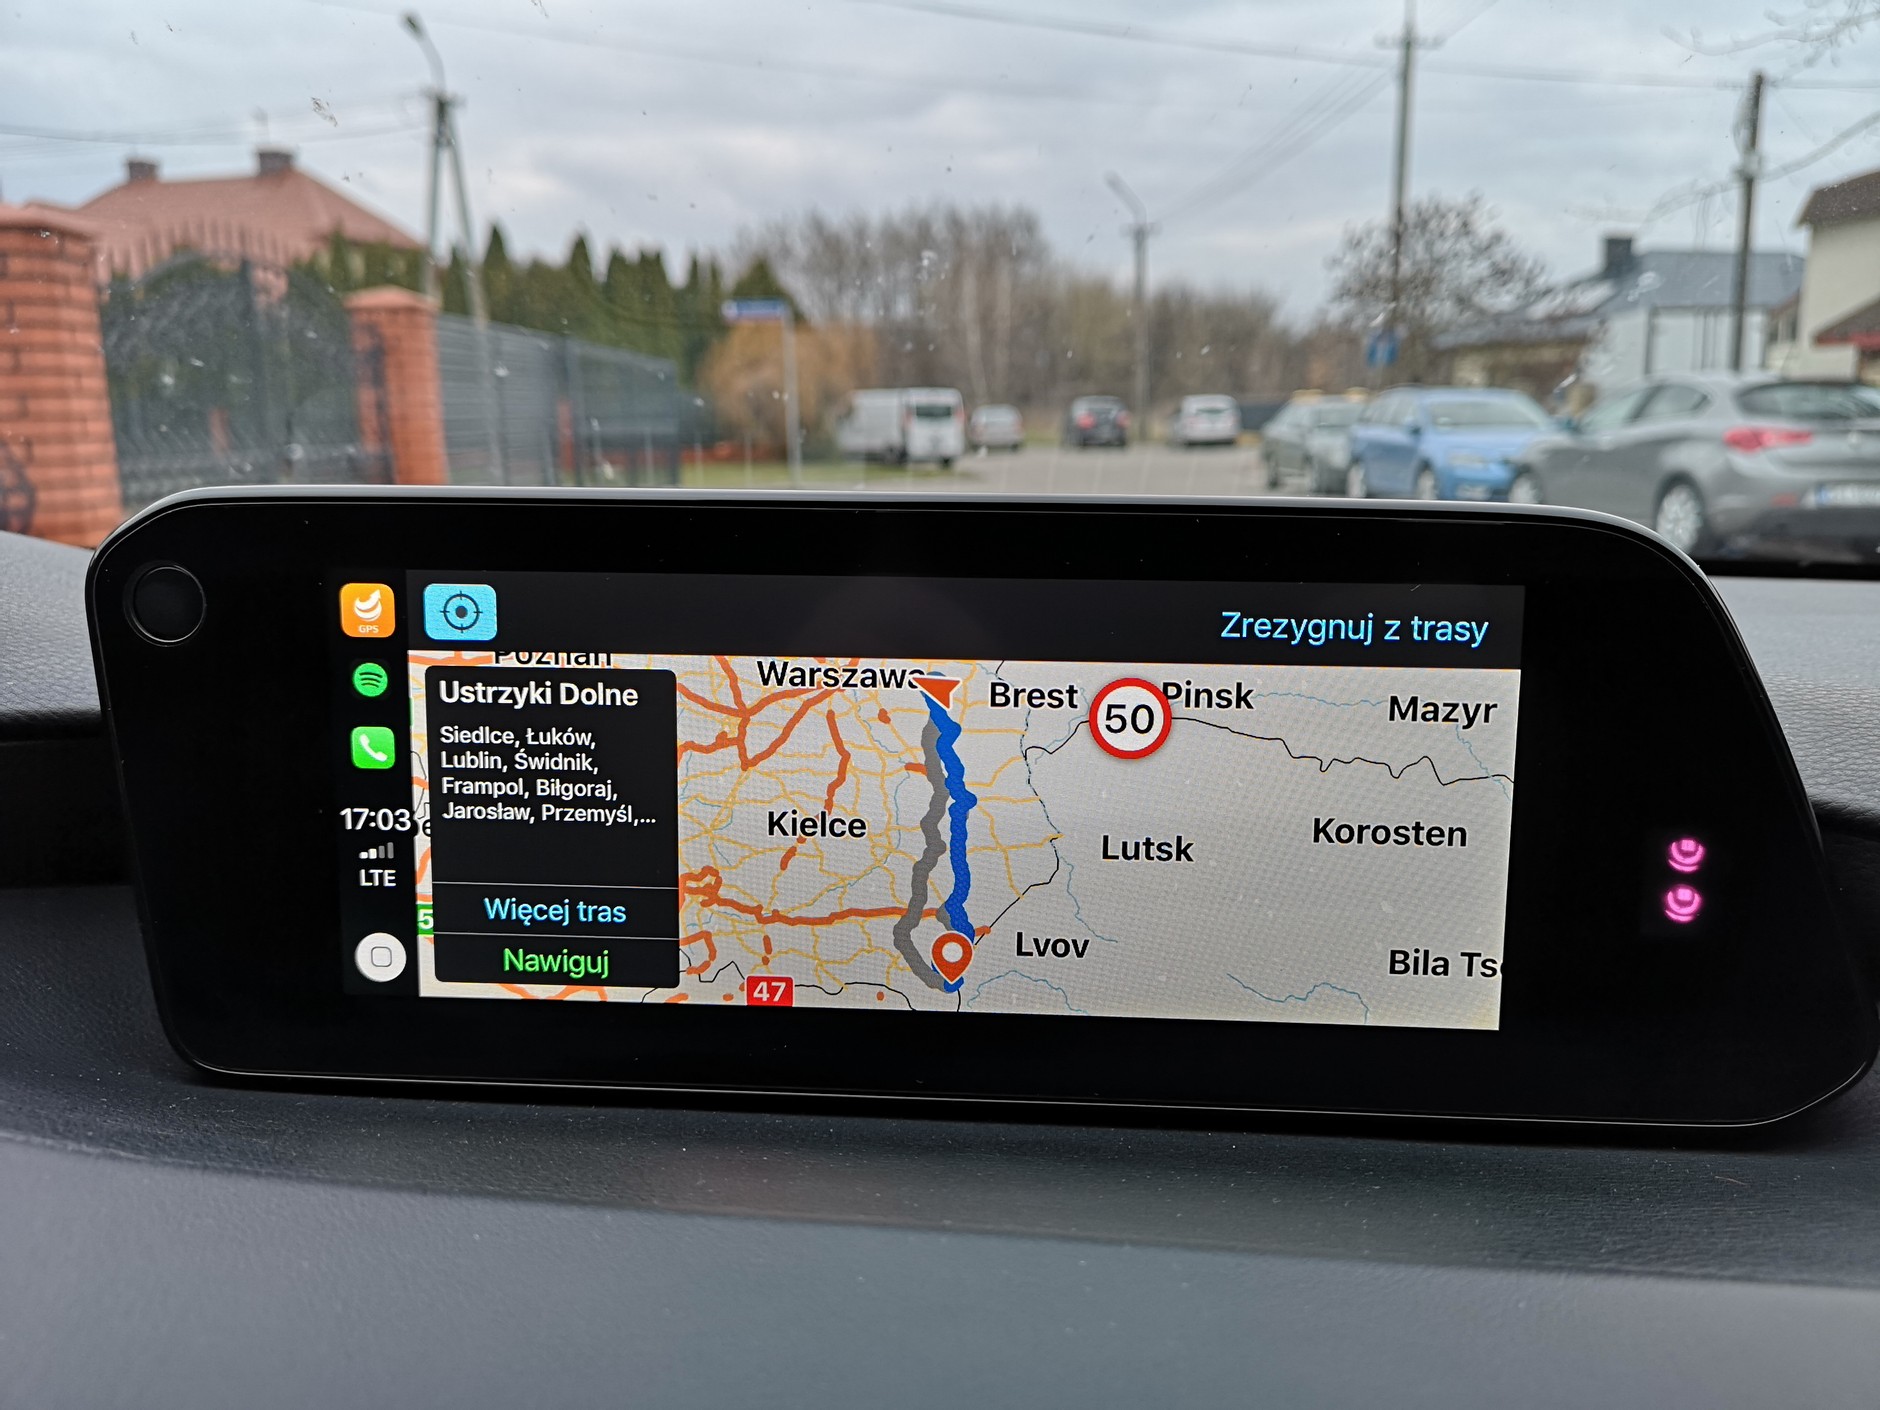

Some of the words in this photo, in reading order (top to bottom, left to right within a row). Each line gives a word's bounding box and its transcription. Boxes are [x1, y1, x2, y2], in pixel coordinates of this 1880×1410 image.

[358, 624, 379, 634] GPS
[1221, 611, 1374, 646] Zrezygnuj
[1384, 619, 1400, 641] z
[1411, 615, 1489, 648] trasy
[439, 680, 552, 709] Ustrzyki
[560, 682, 638, 706] Dolne
[989, 682, 1078, 709] Brest
[1162, 680, 1255, 710] Pinsk
[1105, 703, 1155, 734] 50
[1389, 695, 1498, 729] Mazyr
[440, 726, 520, 748] Siedlce,
[525, 727, 595, 749] Łuków,
[441, 751, 507, 772] Lublin,
[514, 748, 598, 774] Świdnik,
[441, 777, 529, 799] Frampol,
[536, 778, 617, 801] Biłgoraj,
[340, 807, 411, 831] 17:03
[442, 802, 534, 824] Jarosław,
[768, 810, 867, 837] Kielce
[1313, 818, 1467, 847] Korosten
[1102, 834, 1194, 862] Lutsk
[360, 869, 396, 887] LTE
[484, 898, 570, 926] Więcej
[577, 901, 627, 923] tras
[1016, 932, 1089, 959] Lvov
[503, 948, 609, 979] Nawiguj
[1389, 948, 1450, 976] Bila
[1460, 951, 1503, 978] Ts
[753, 982, 786, 1002] 47
